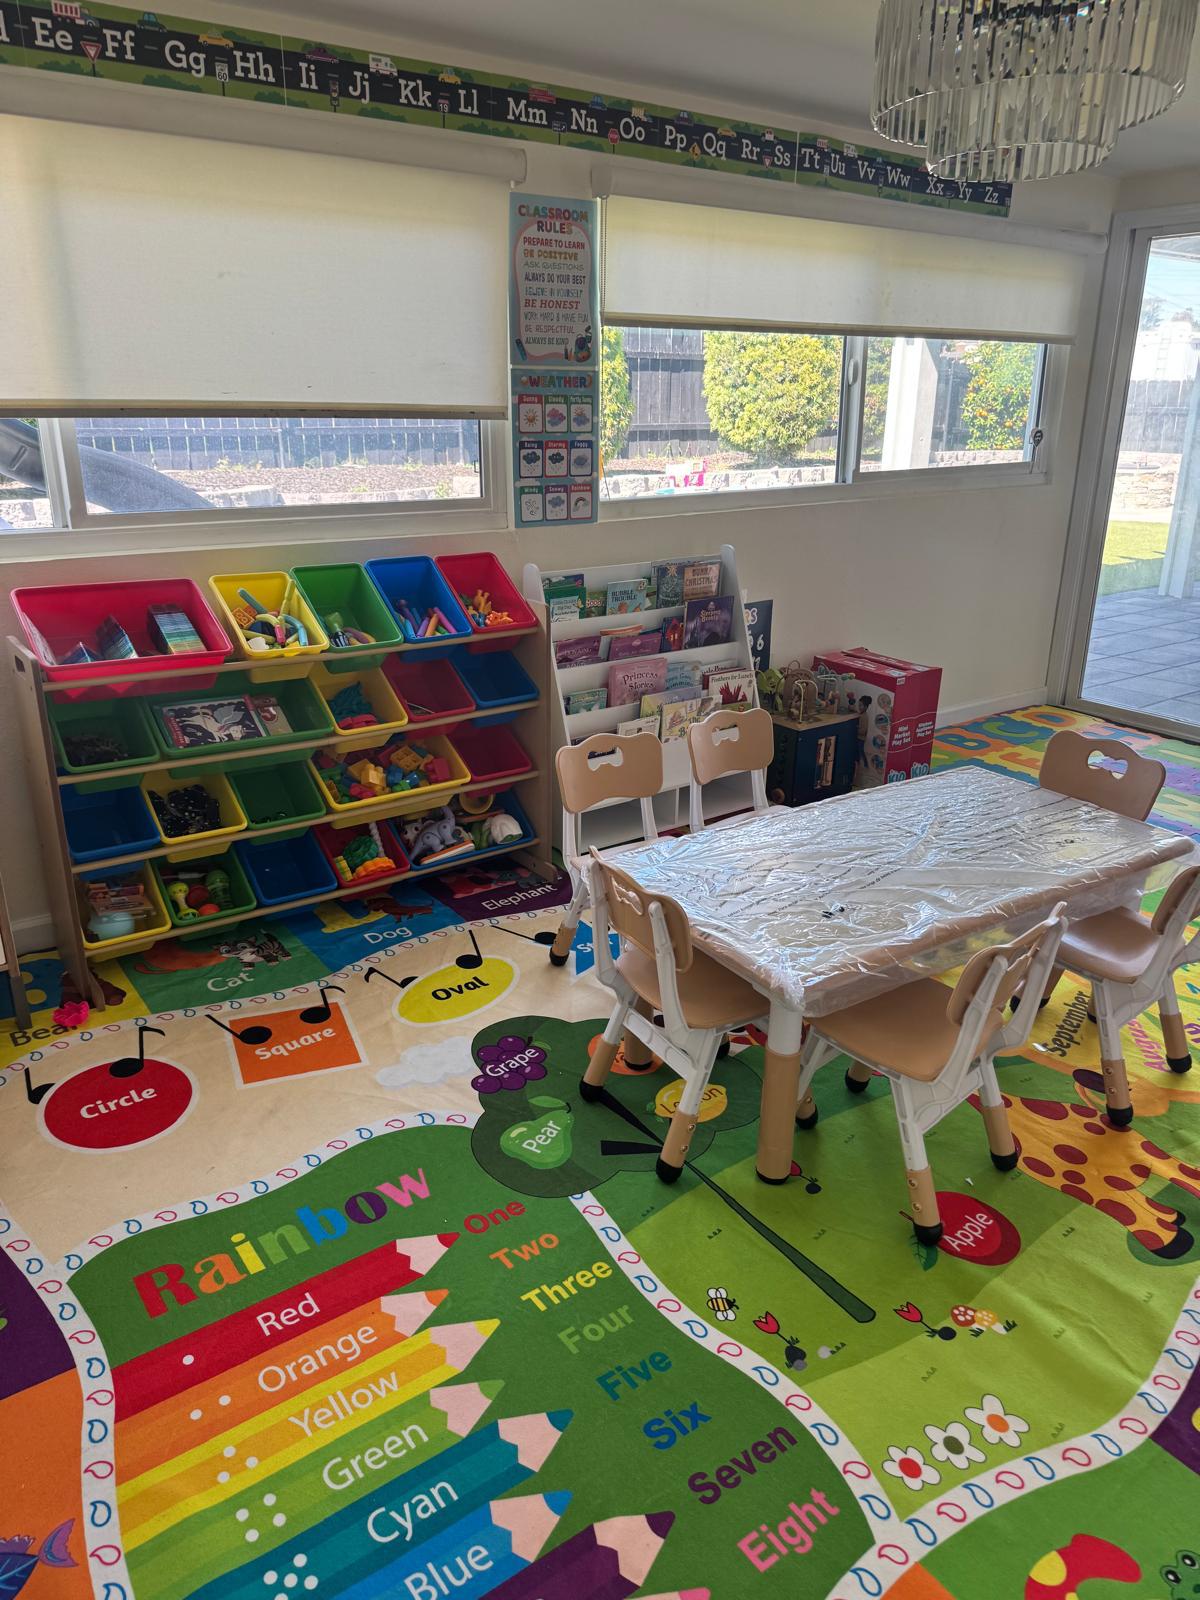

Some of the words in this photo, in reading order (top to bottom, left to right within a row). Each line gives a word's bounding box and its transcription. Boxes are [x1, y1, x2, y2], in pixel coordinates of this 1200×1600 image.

[217, 71, 228, 81] 60
[31, 17, 73, 50] Ee
[102, 29, 136, 61] Ff
[165, 40, 206, 78] Gg
[233, 51, 276, 83] Hh
[299, 62, 320, 90] Ii
[349, 71, 370, 103] Jj
[398, 79, 432, 108] Kk
[458, 89, 479, 115] Ll
[507, 98, 548, 124] Mm
[570, 108, 599, 134] Nn
[619, 117, 645, 141] Oo
[664, 125, 687, 153] Pp
[703, 132, 726, 160] Qq
[741, 139, 760, 160] Rr
[774, 145, 791, 166] Ss
[801, 148, 820, 169] Tt
[830, 154, 846, 176] Uu
[858, 160, 876, 181] Vv
[886, 166, 911, 188] Ww
[926, 177, 944, 195] Xx
[957, 181, 972, 203] Yy
[984, 187, 999, 204] Zz
[518, 204, 589, 223] CLASSROOM
[537, 220, 573, 235] RULES
[523, 236, 553, 247] PREPARE
[555, 239, 563, 248] TO
[564, 240, 585, 250] LEARN
[524, 249, 535, 258] BE
[537, 250, 579, 261] POSITIVE
[524, 272, 545, 282] ALWAYS
[547, 273, 555, 283] DO
[556, 274, 570, 284] YOUR
[572, 275, 586, 285] BEST
[524, 299, 536, 308] BE
[540, 300, 581, 310] HONEST
[525, 336, 546, 345] ALWAYS
[529, 375, 588, 389] WEATHER
[622, 671, 658, 685] Princess
[628, 681, 654, 691] Stories
[481, 882, 557, 911] Elephant
[363, 926, 413, 944] Dog
[207, 969, 254, 992] Cat
[431, 976, 490, 1002] Oval
[9, 1024, 78, 1048] Bea
[1047, 990, 1092, 1057] September
[254, 1027, 336, 1061] Square
[485, 1047, 539, 1078] Grape
[79, 1086, 157, 1120] Circle
[660, 1085, 724, 1116] Leon
[521, 1119, 562, 1155] Pear
[463, 1201, 527, 1234] One
[942, 1211, 994, 1252] Apple
[132, 1168, 432, 1320] Rainbow
[489, 1233, 560, 1270] Two
[520, 1261, 613, 1312] Three
[256, 1292, 321, 1338] Red
[558, 1304, 635, 1355] Four
[257, 1323, 379, 1393] Orange
[596, 1351, 673, 1400] Five
[288, 1371, 400, 1437] Yellow
[642, 1401, 712, 1450] Six
[322, 1423, 430, 1491] Green
[687, 1425, 798, 1505] Seven
[366, 1480, 460, 1544] Cyan
[737, 1487, 840, 1573] Eight
[404, 1544, 494, 1600] Blue
